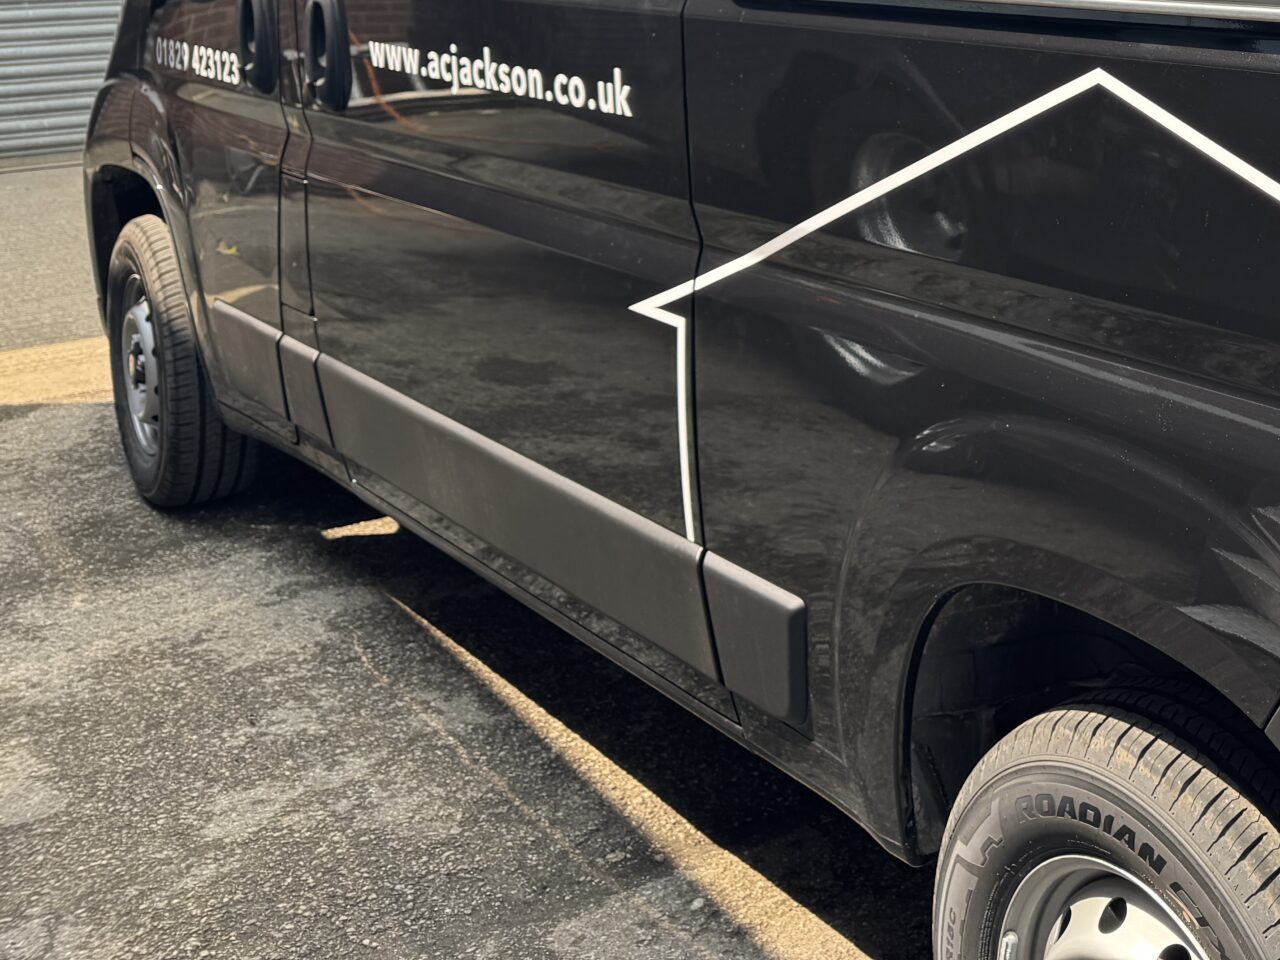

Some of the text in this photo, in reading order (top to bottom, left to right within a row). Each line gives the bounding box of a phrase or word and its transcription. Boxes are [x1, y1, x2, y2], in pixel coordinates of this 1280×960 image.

[156, 36, 240, 85] 01829 423123
[368, 40, 633, 118] www.acjackson.co.uk
[1014, 792, 1167, 876] ROADIAN
